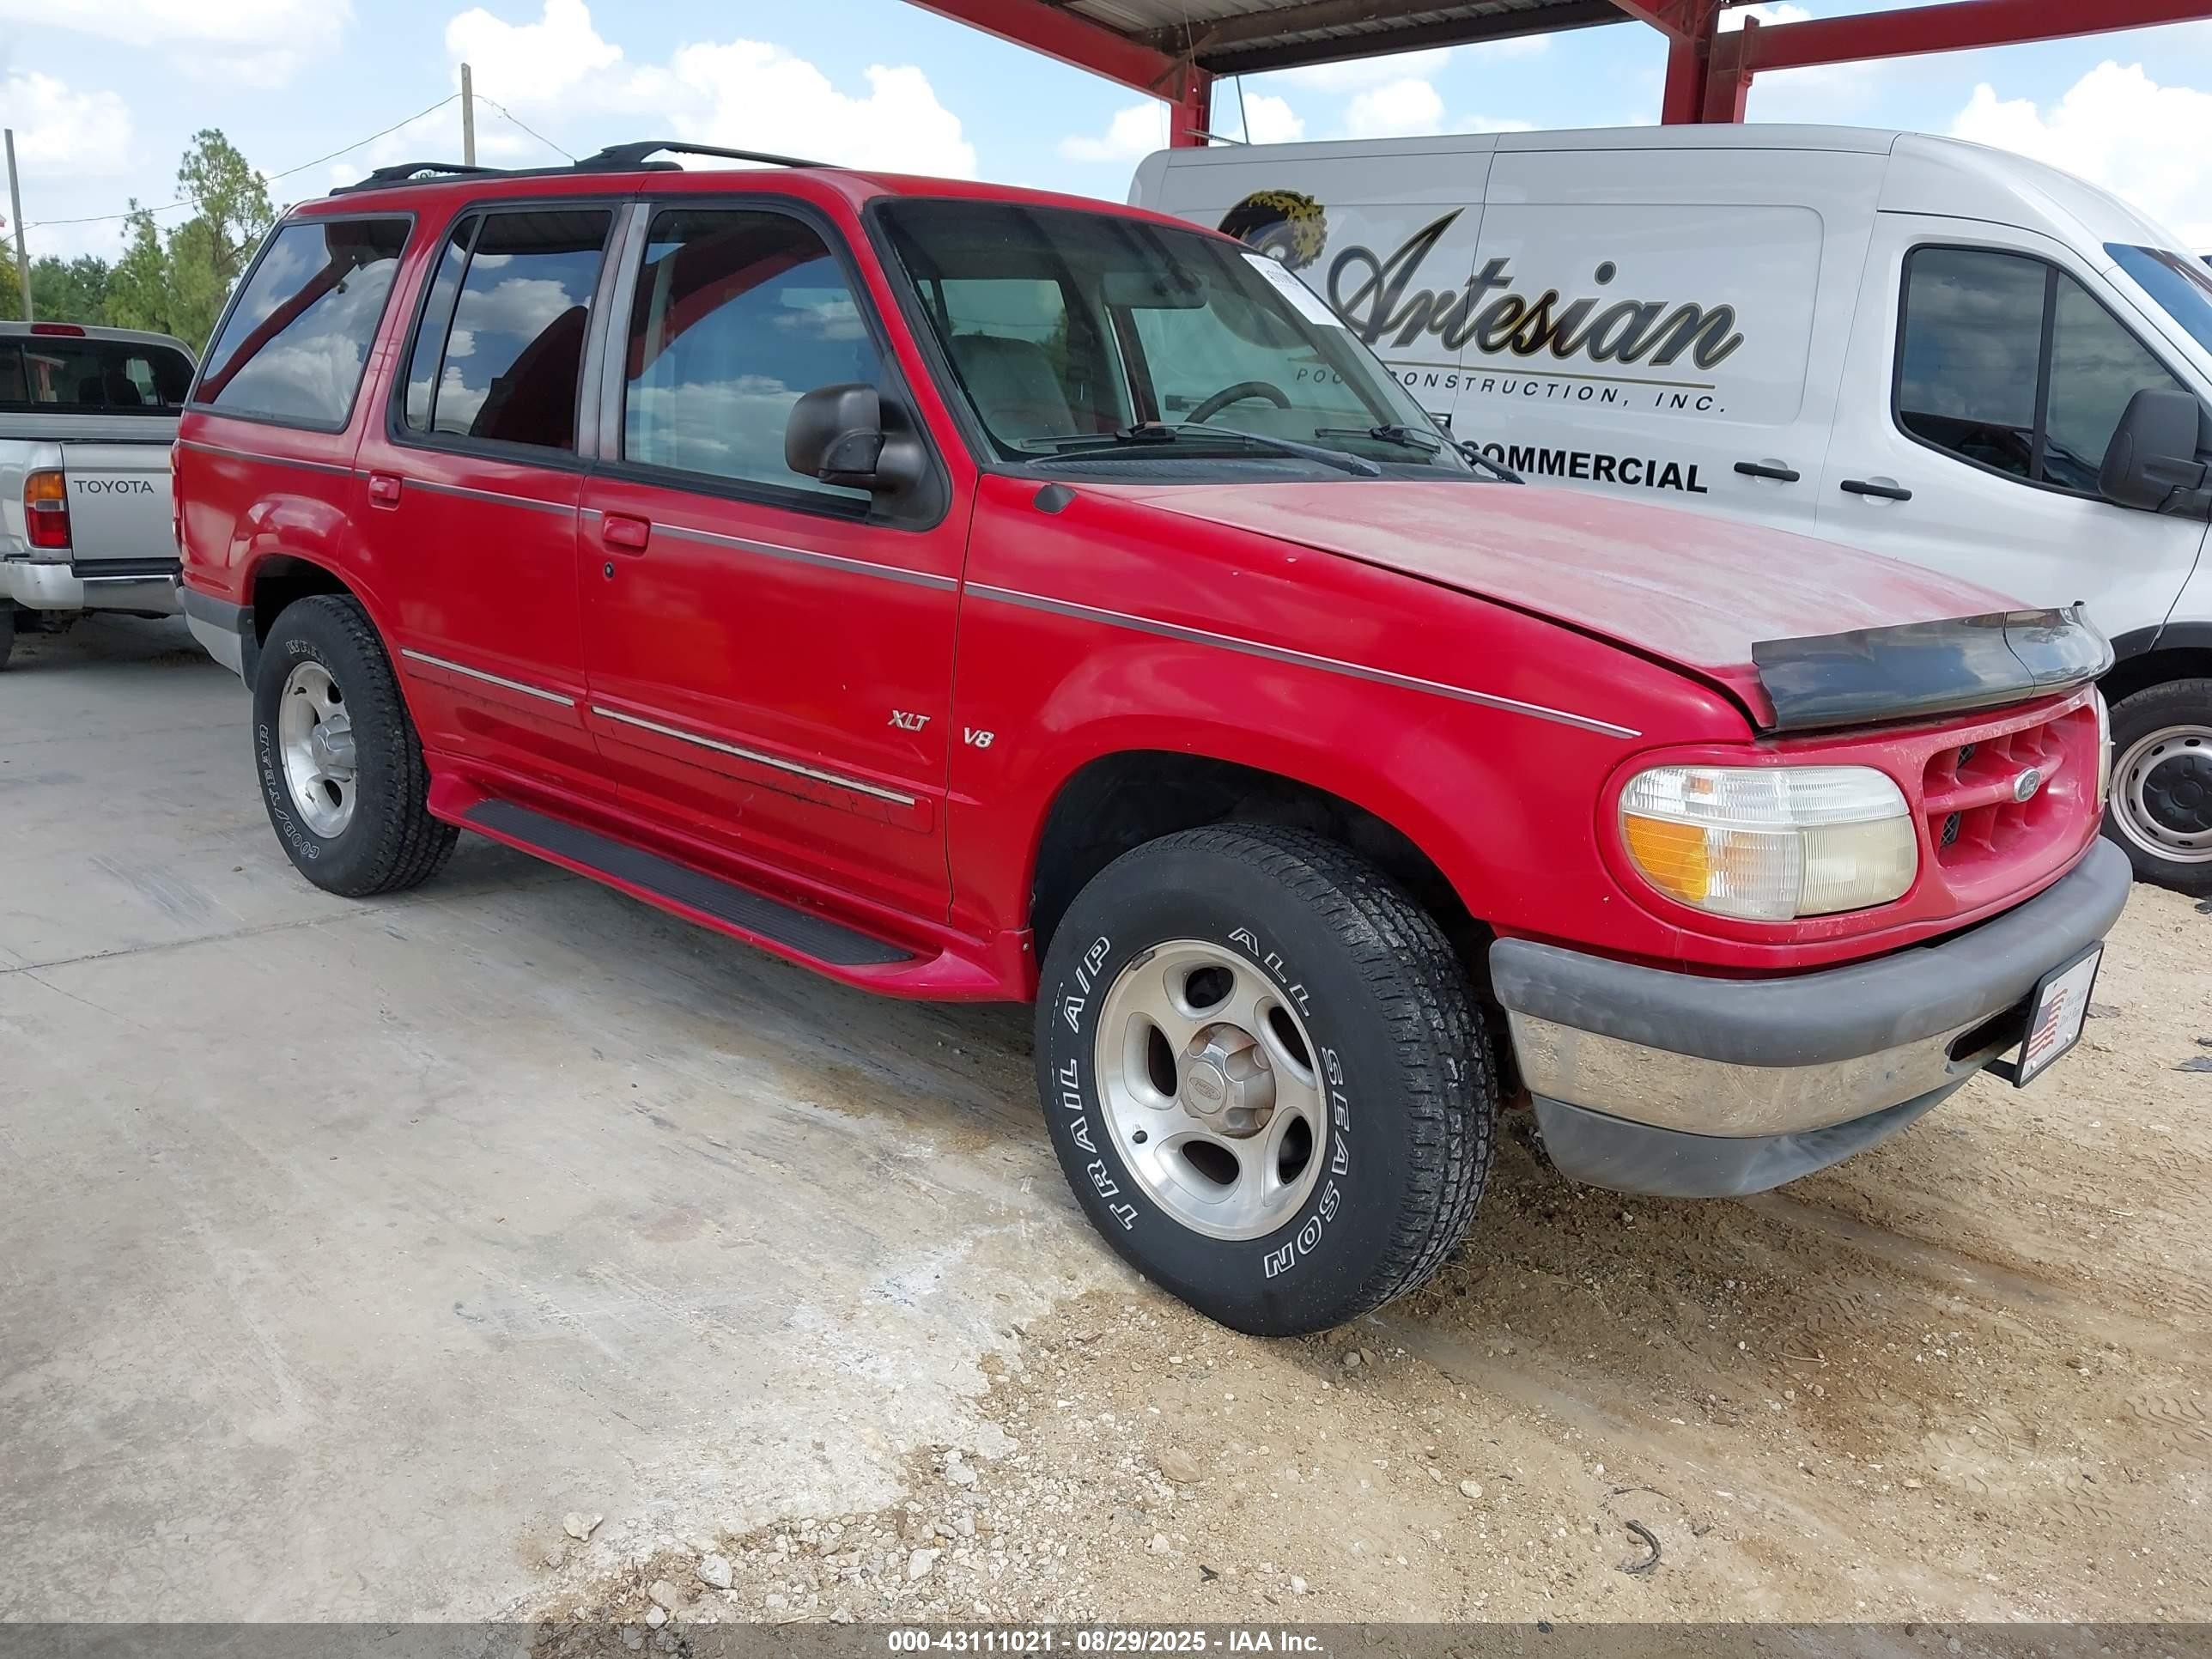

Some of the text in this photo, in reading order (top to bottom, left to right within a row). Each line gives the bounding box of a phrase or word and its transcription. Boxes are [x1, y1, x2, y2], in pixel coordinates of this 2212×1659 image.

[1326, 207, 1746, 371] Artesian
[1297, 368, 1725, 412] POO ONSTRUCTION, INC.
[73, 480, 155, 494] TOYOTA
[887, 709, 931, 732] XLT
[963, 727, 994, 748] V8
[1059, 936, 1139, 1231] TRAIL A/P
[1229, 927, 1352, 1279] ALL SEASON
